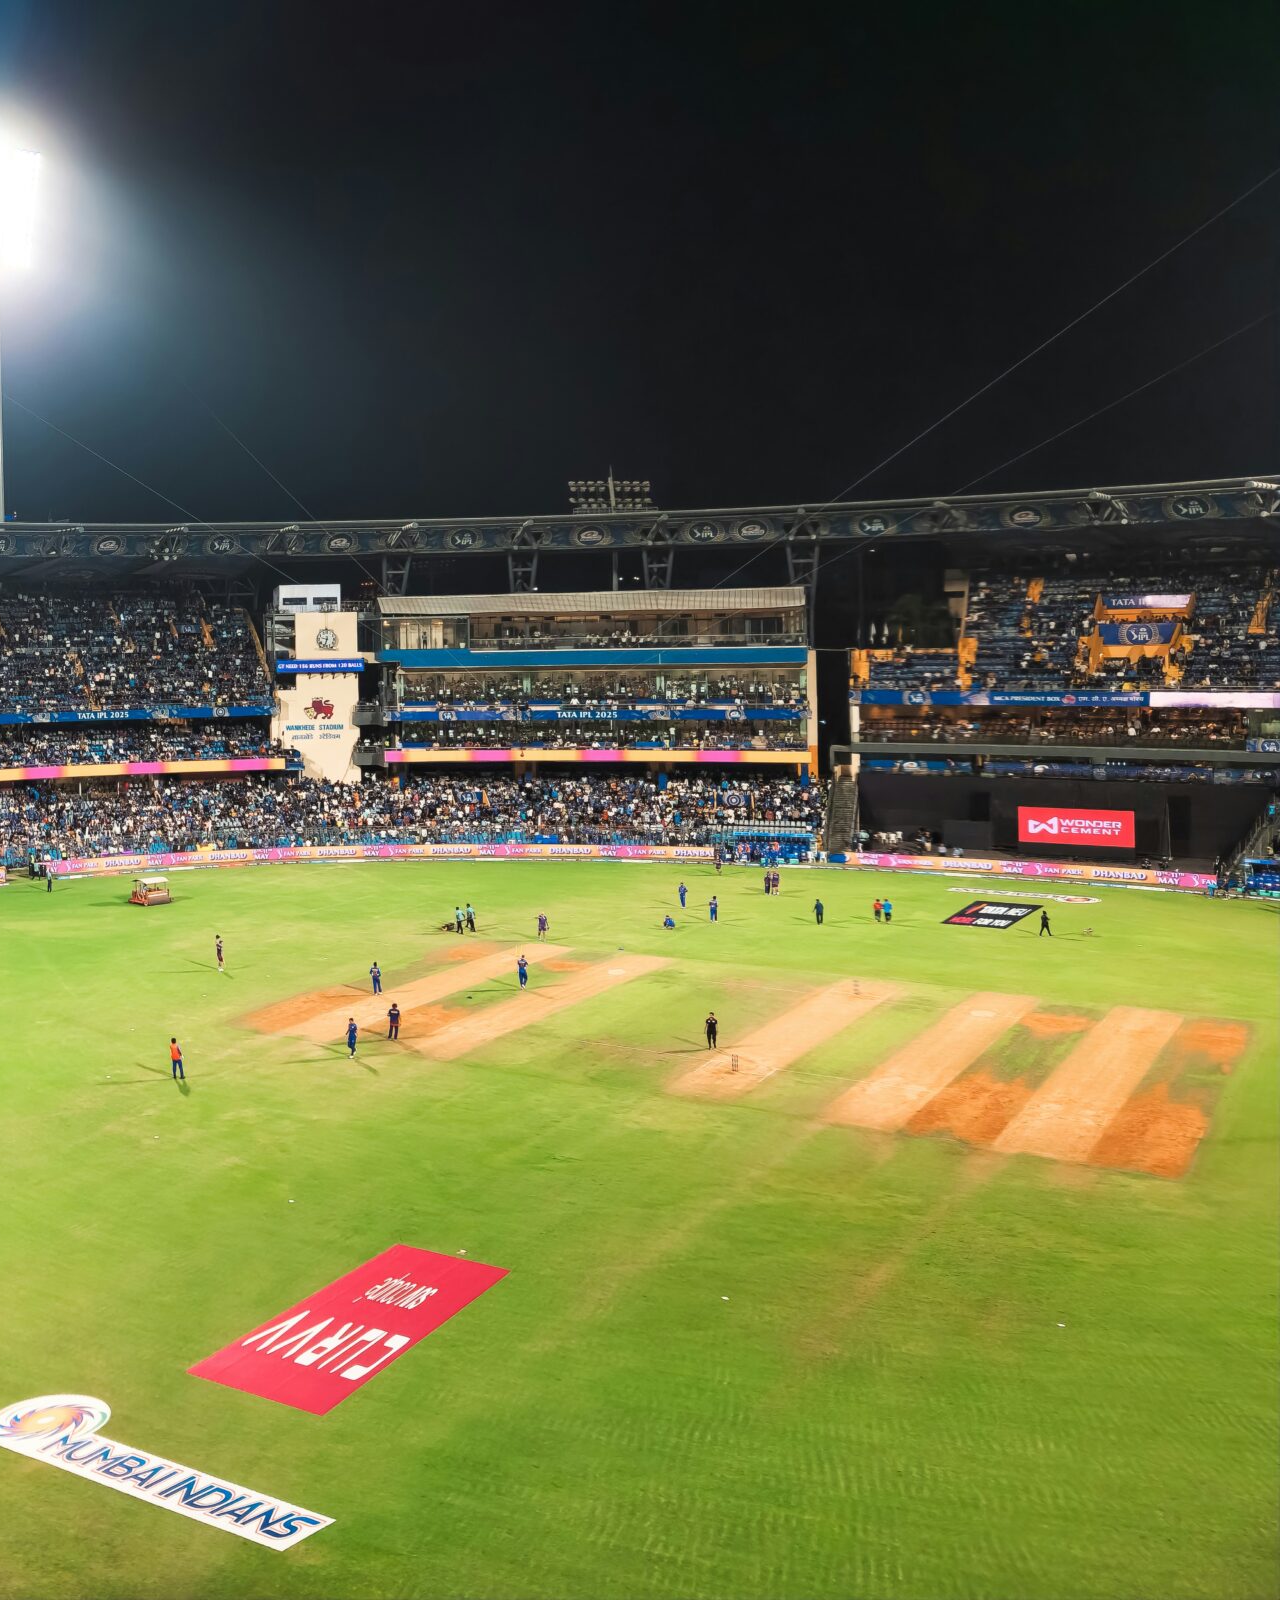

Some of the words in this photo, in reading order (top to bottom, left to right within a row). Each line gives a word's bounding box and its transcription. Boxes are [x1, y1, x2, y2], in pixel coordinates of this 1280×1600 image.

[1111, 598, 1136, 606] TATA
[77, 712, 95, 720] TATA
[97, 711, 108, 719] IPL
[110, 711, 129, 719] 2025
[557, 711, 578, 719] TATA
[579, 711, 593, 719] IPL
[595, 711, 618, 719] 2025
[1060, 818, 1122, 829] WONDER
[1061, 827, 1121, 836] CEMENT
[317, 848, 356, 857] DHANBAD
[431, 847, 472, 855] DHANBAD
[549, 847, 591, 855] DHANBAD
[208, 852, 247, 860] DHANBAD
[104, 859, 141, 868] DHANBAD
[942, 860, 992, 870] DHANBAD
[1002, 866, 1024, 874] MAY
[1093, 869, 1148, 880] DHANBAD
[1158, 877, 1180, 885] MAY
[991, 919, 1012, 927] YOU
[241, 1310, 411, 1381] CURVV
[41, 1435, 177, 1489] MUMBAI
[158, 1476, 321, 1539] INDIANS
